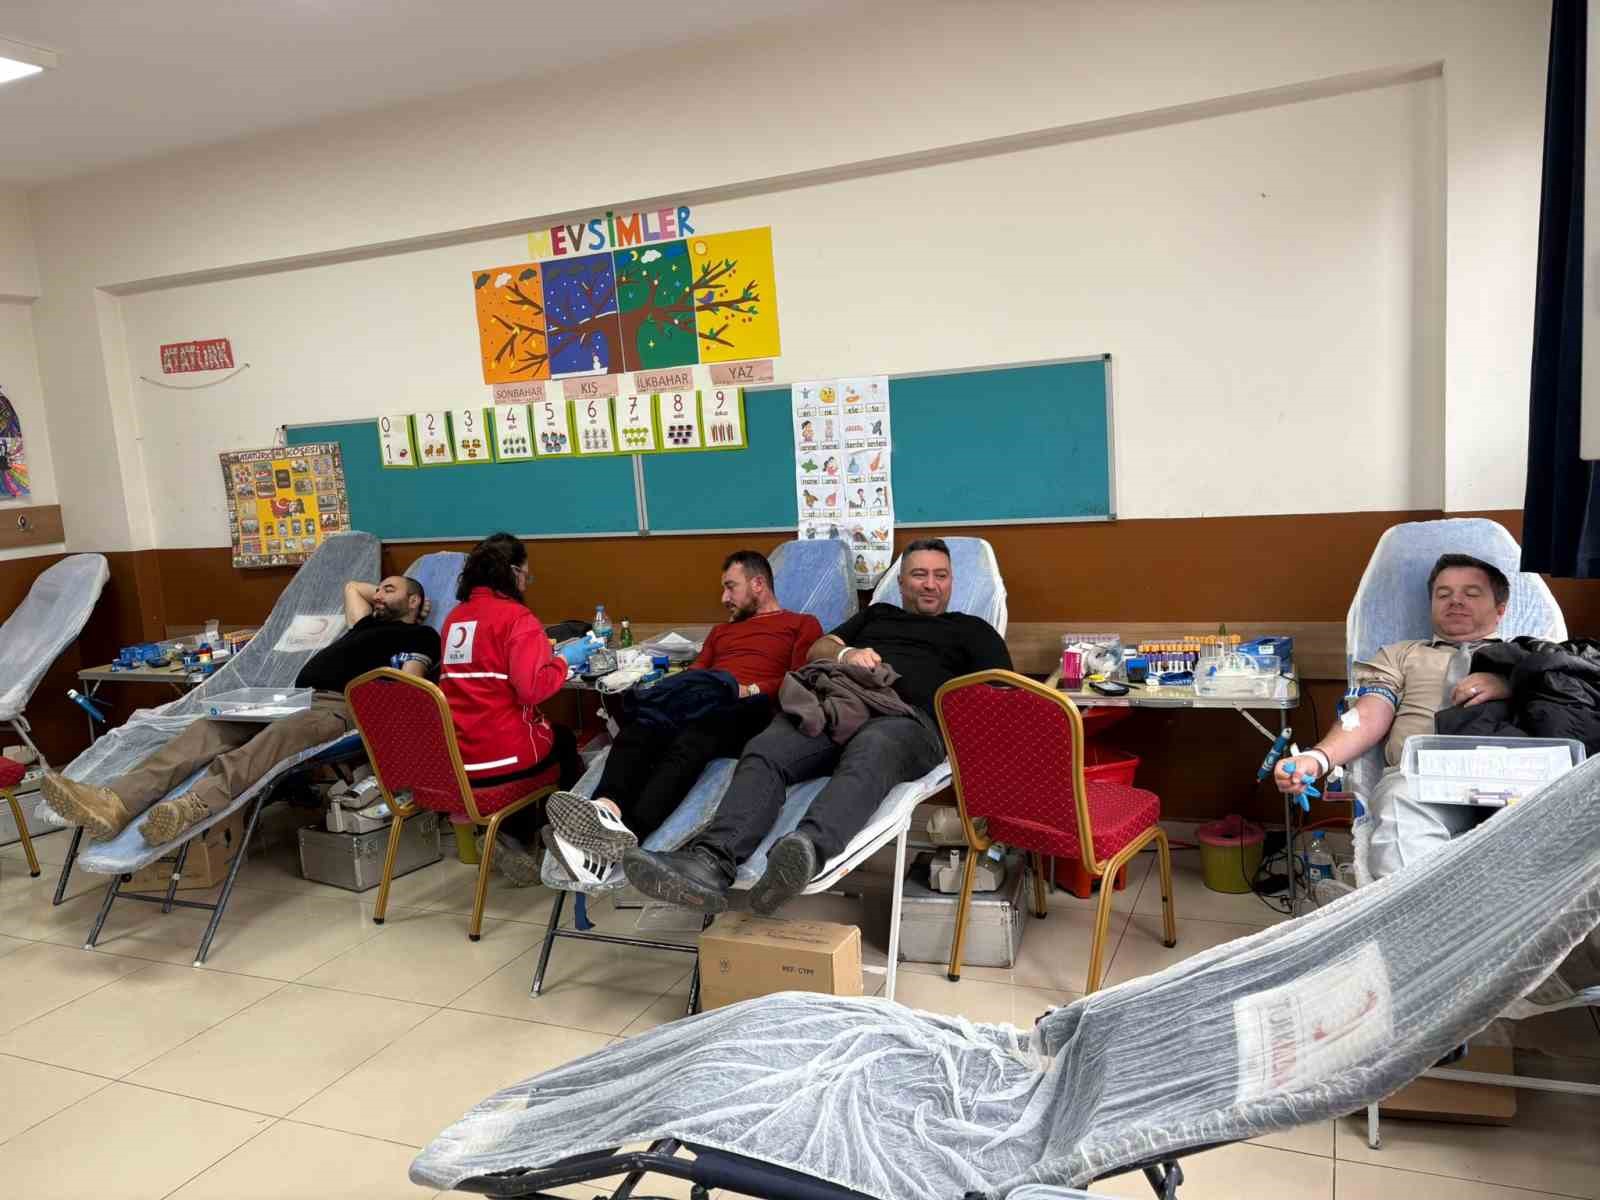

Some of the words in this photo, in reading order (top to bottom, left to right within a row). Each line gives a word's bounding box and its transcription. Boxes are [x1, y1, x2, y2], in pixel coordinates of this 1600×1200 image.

[528, 205, 695, 258] MEVSİMLER
[728, 365, 754, 379] YAZ
[496, 386, 544, 400] SONBAHAR
[715, 391, 725, 409] 9
[545, 402, 555, 420] 5
[587, 401, 597, 418] 6
[628, 397, 638, 415] 7
[673, 394, 683, 412] 8
[381, 416, 391, 432] 0
[426, 414, 435, 430] 2
[464, 410, 473, 427] 3
[506, 408, 516, 424] 4
[385, 443, 392, 459] 1
